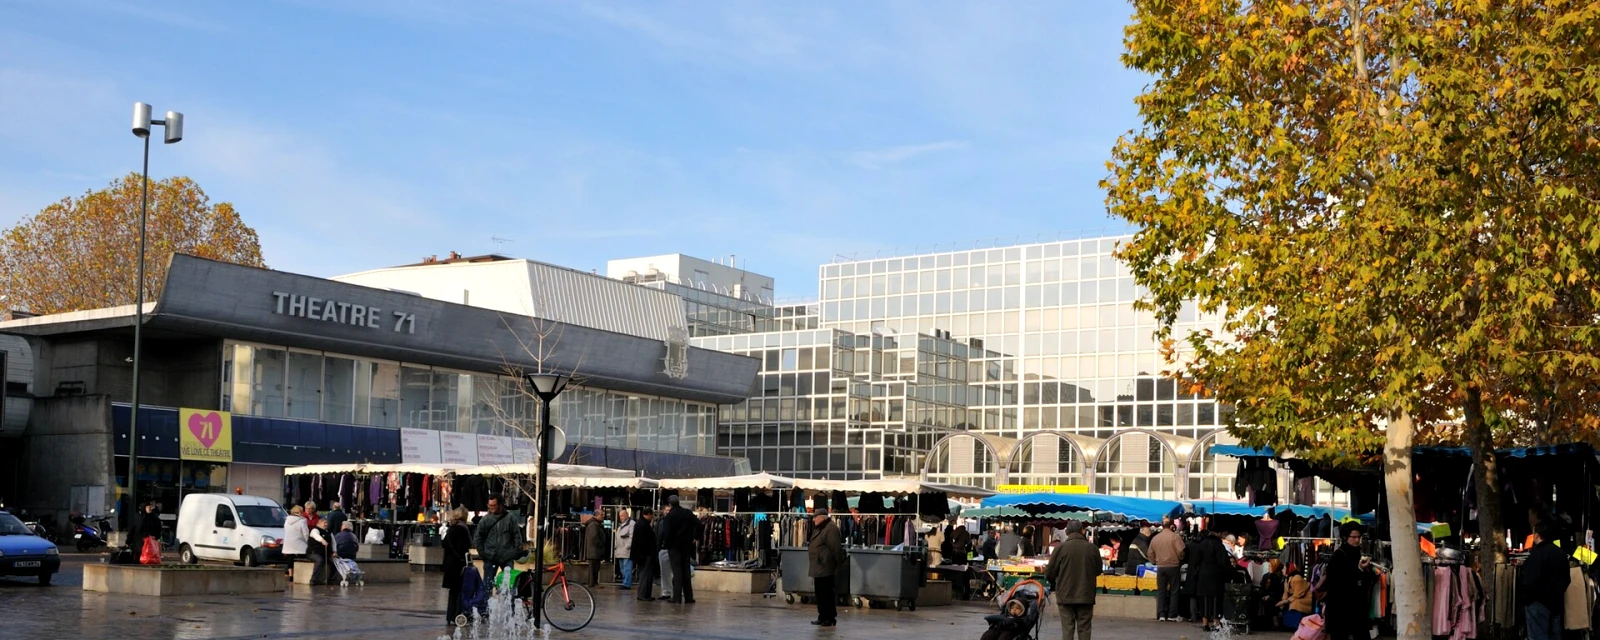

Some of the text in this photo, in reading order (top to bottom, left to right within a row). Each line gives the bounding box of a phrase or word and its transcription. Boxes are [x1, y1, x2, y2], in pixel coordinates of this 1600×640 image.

[273, 291, 416, 334] THEATRE 71
[199, 421, 213, 439] 71
[182, 447, 190, 456] WE
[191, 447, 203, 456] LOVE
[203, 448, 210, 457] CE
